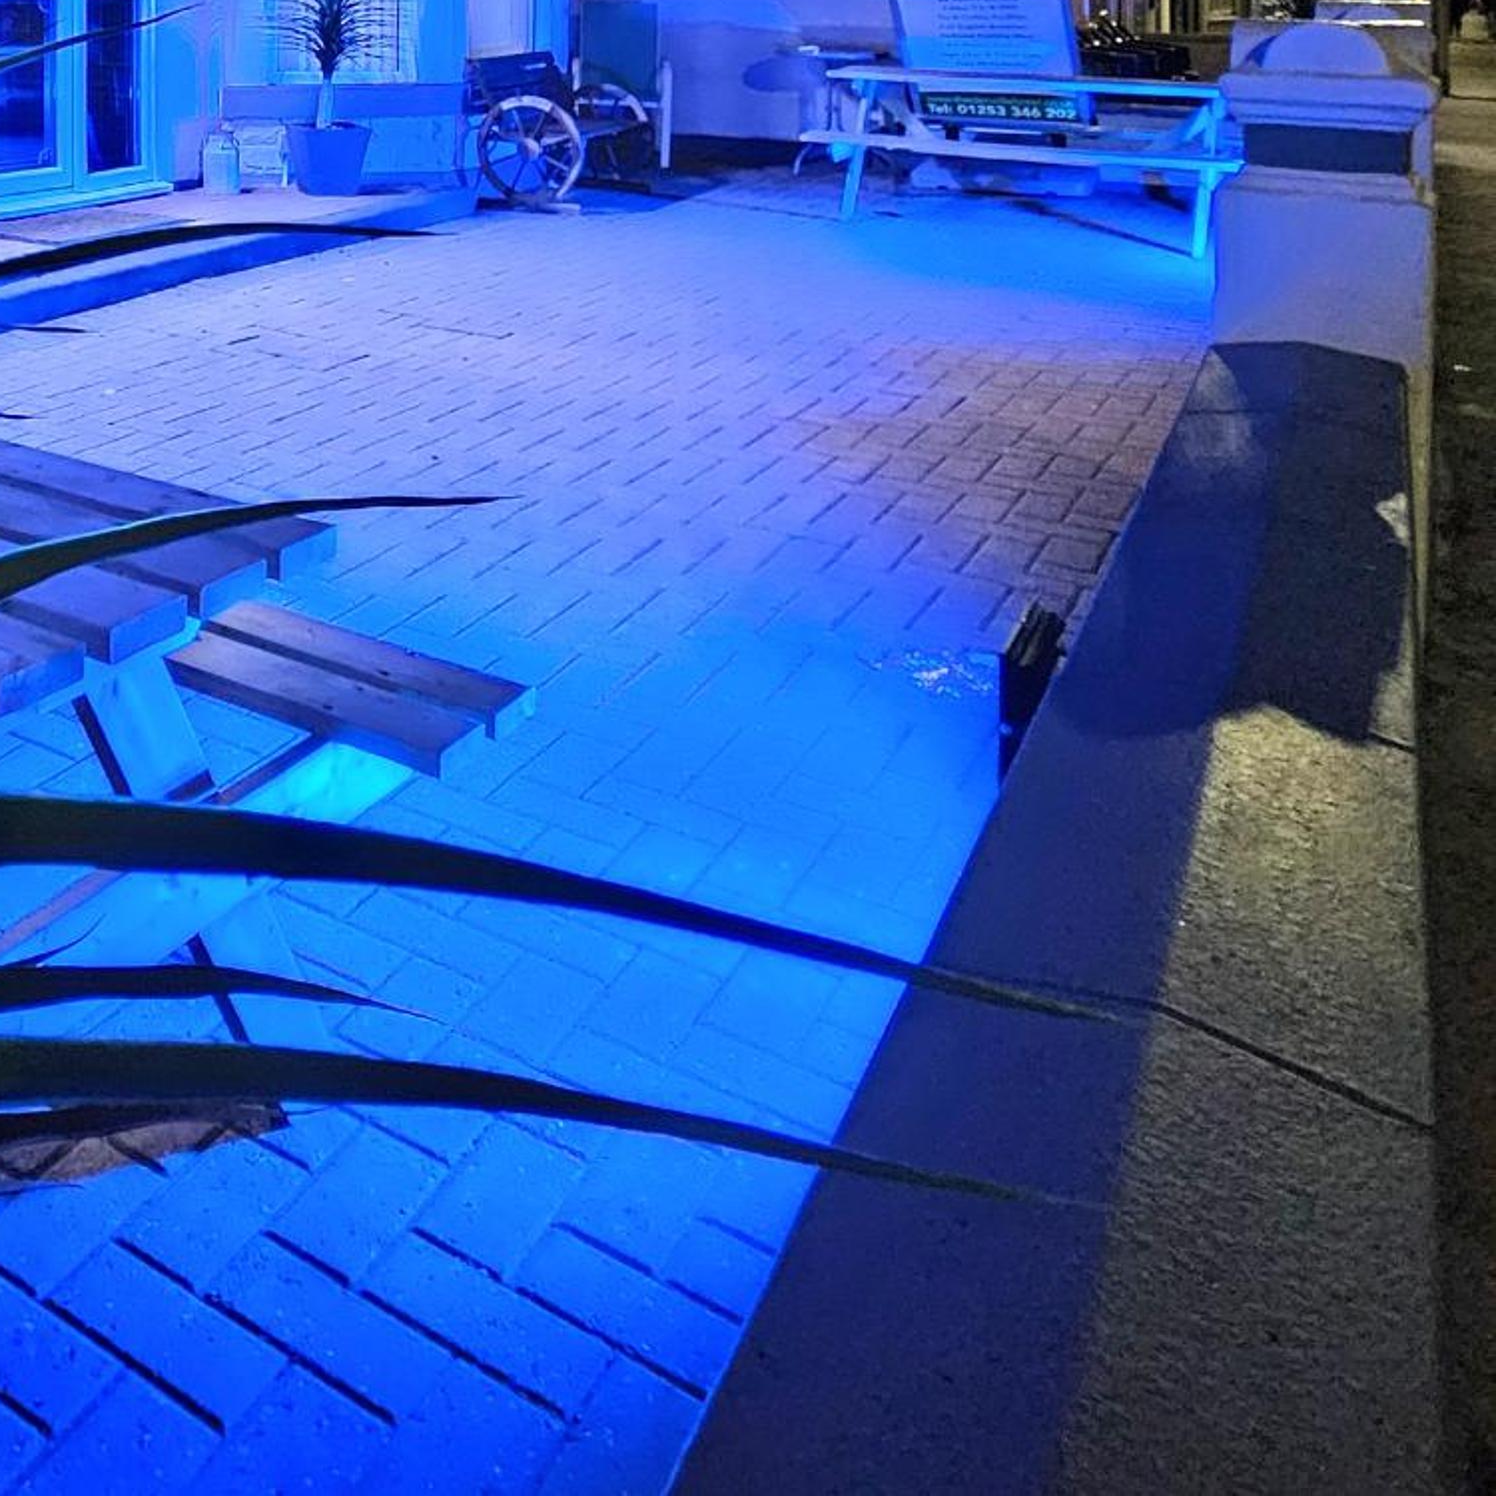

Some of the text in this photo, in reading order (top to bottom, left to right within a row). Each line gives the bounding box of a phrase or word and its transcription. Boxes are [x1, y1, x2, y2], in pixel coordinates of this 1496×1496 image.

[928, 103, 1077, 120] Tel: 01253 346 202
